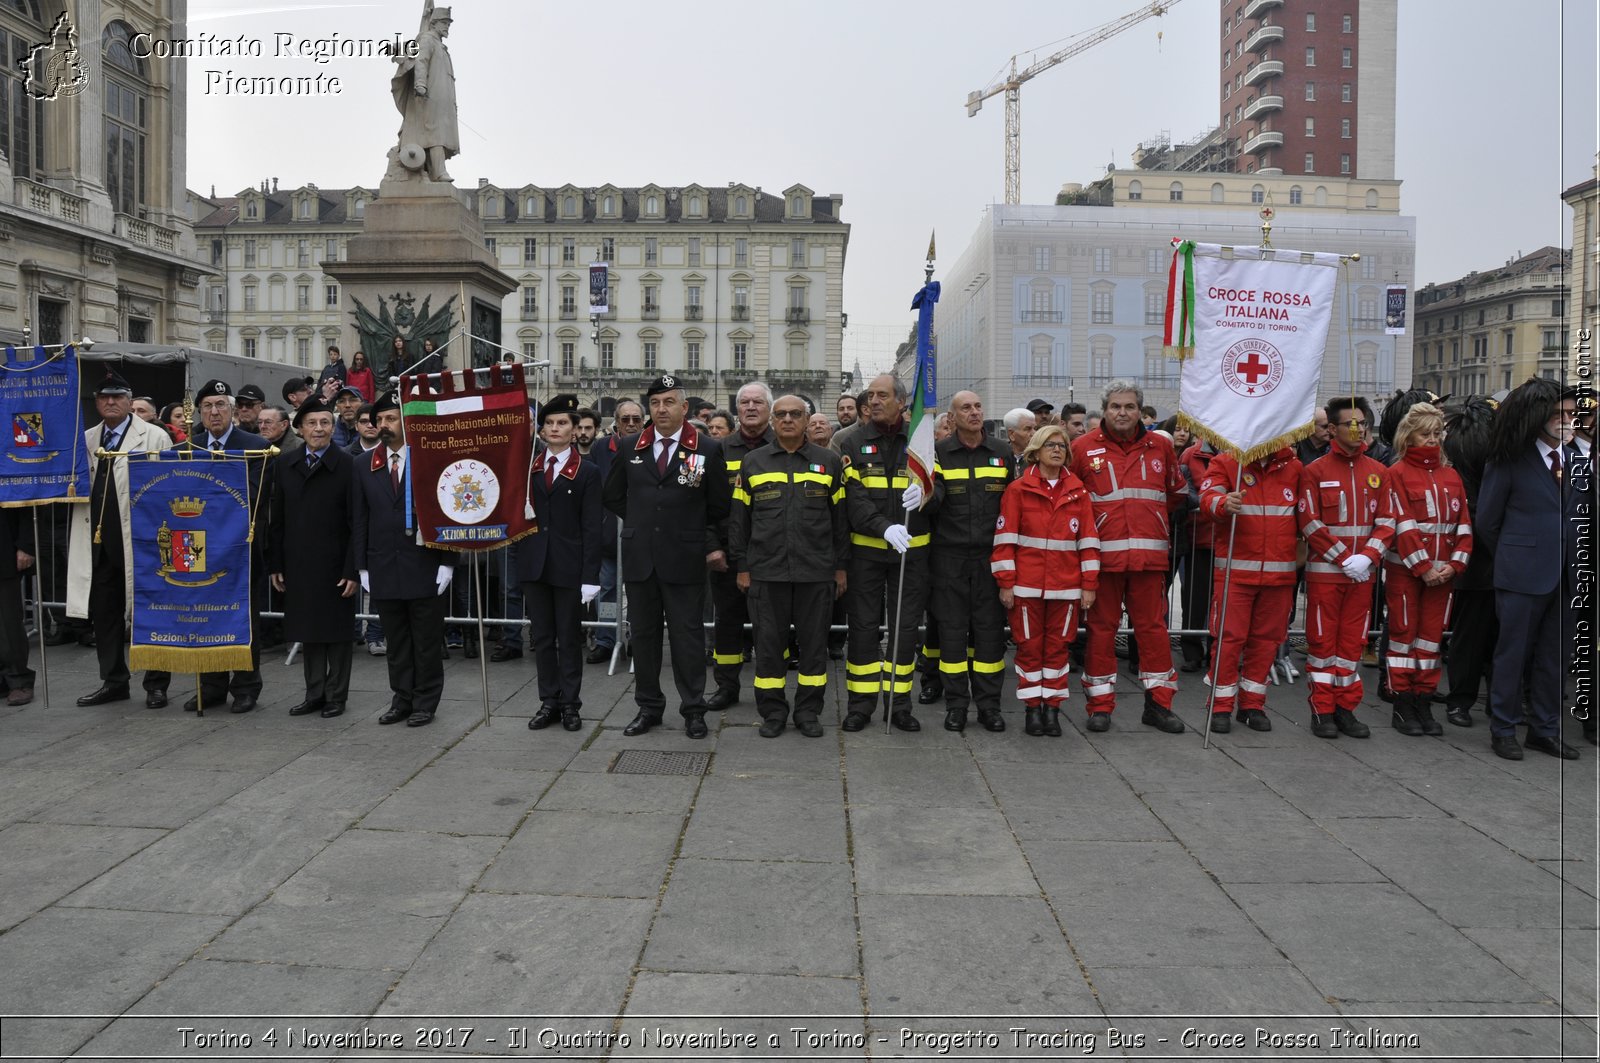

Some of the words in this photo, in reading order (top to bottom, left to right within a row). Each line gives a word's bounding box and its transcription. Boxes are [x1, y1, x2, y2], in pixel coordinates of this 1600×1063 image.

[1208, 287, 1256, 302] CROCE
[1263, 291, 1311, 306] ROSSA
[1225, 305, 1289, 321] ITALIANA
[1215, 320, 1255, 329] COMITATO
[1269, 324, 1298, 332] TORINO
[1224, 350, 1241, 389] CONVENZIONE
[1235, 344, 1243, 353] DI
[1243, 341, 1271, 354] GINEVRA
[32, 375, 68, 387] NAZIONALE
[454, 416, 496, 430] Nazionale
[497, 413, 525, 426] Militari
[421, 436, 447, 449] Croce
[448, 436, 474, 448] Rossa
[476, 434, 509, 446] Italiana
[11, 476, 32, 486] PIEMONTE
[34, 476, 38, 484] E
[39, 476, 55, 484] VALLE
[130, 471, 169, 508] Associazione
[172, 468, 214, 481] Nazionale
[215, 477, 248, 509] ex-allievi
[442, 529, 468, 540] SEZIONE
[469, 528, 476, 540] DI
[477, 527, 502, 539] TORINO
[148, 602, 190, 612] Accademia
[192, 602, 228, 612] Militare
[231, 602, 240, 610] di
[176, 613, 208, 623] Modena
[150, 631, 188, 642] Sezione
[189, 632, 235, 643] Piemonte
